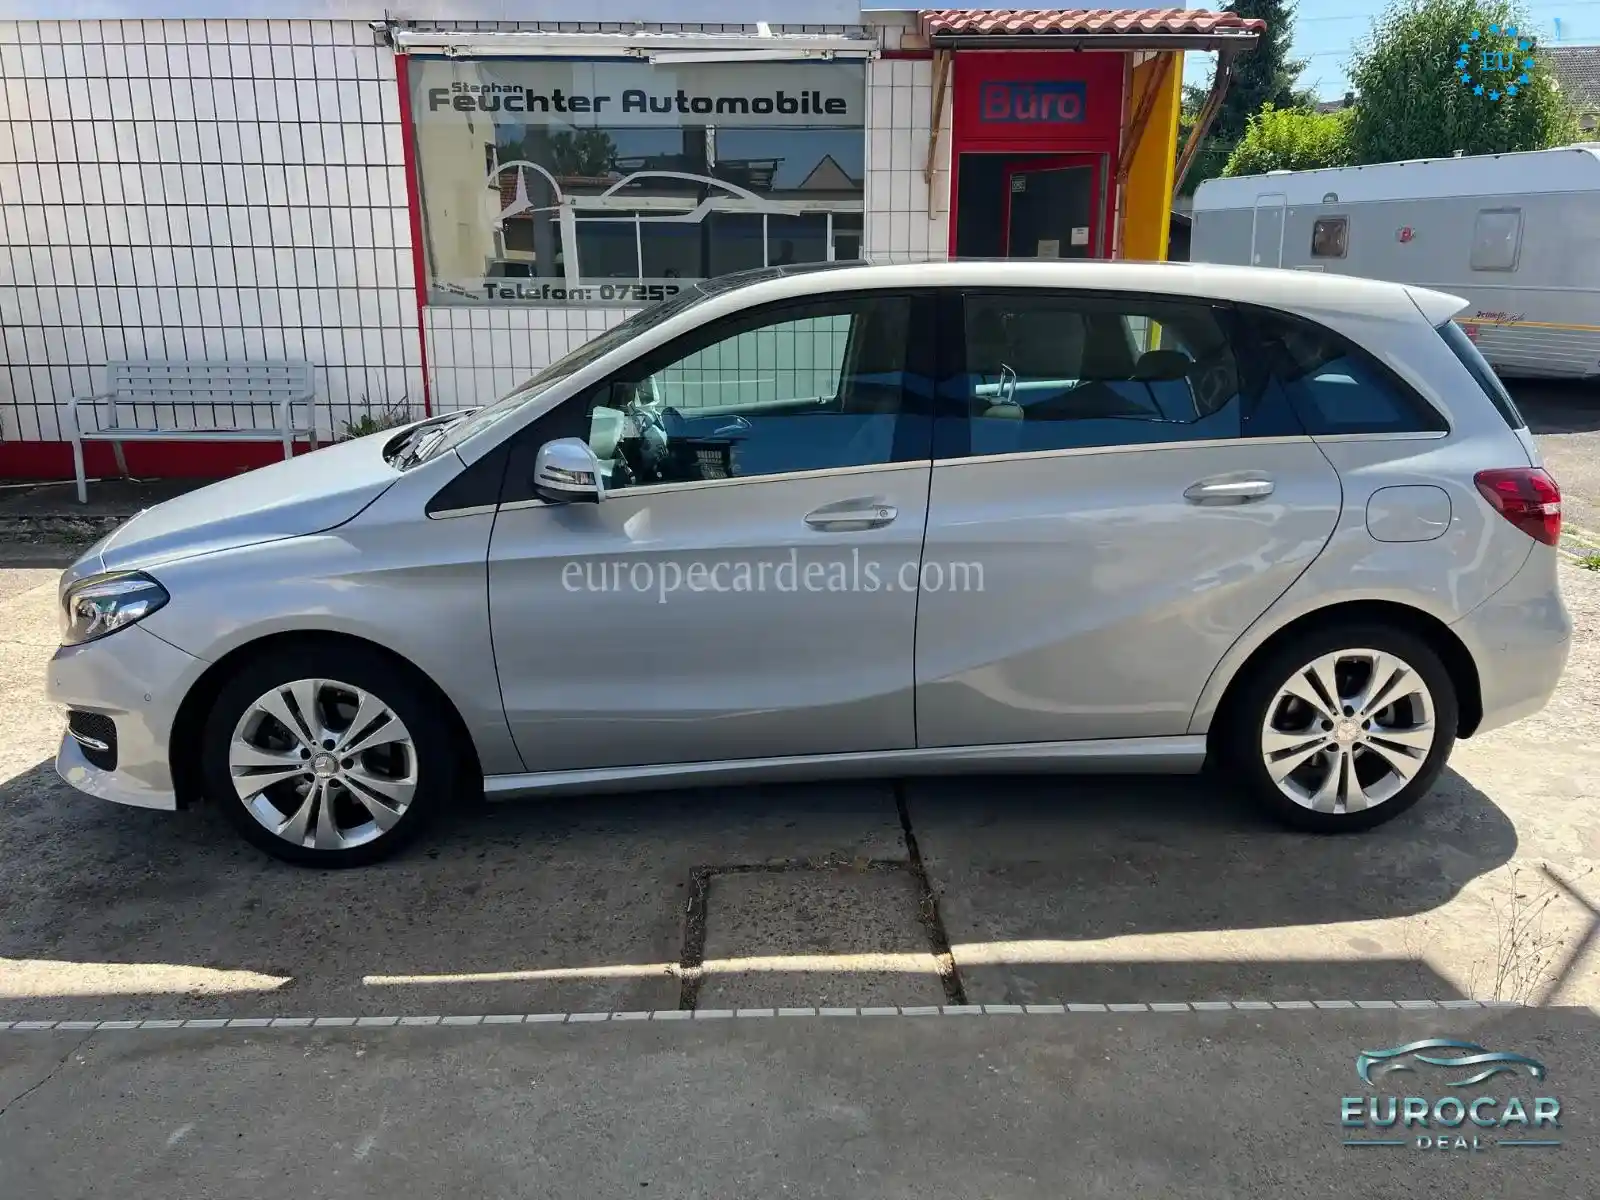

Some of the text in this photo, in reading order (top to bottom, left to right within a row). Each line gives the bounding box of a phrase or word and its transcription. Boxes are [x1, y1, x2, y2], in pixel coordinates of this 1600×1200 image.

[451, 82, 523, 93] Stephan
[428, 88, 848, 114] Feuchter Automobile
[984, 85, 1080, 119] Büro
[483, 283, 591, 300] Telefon:
